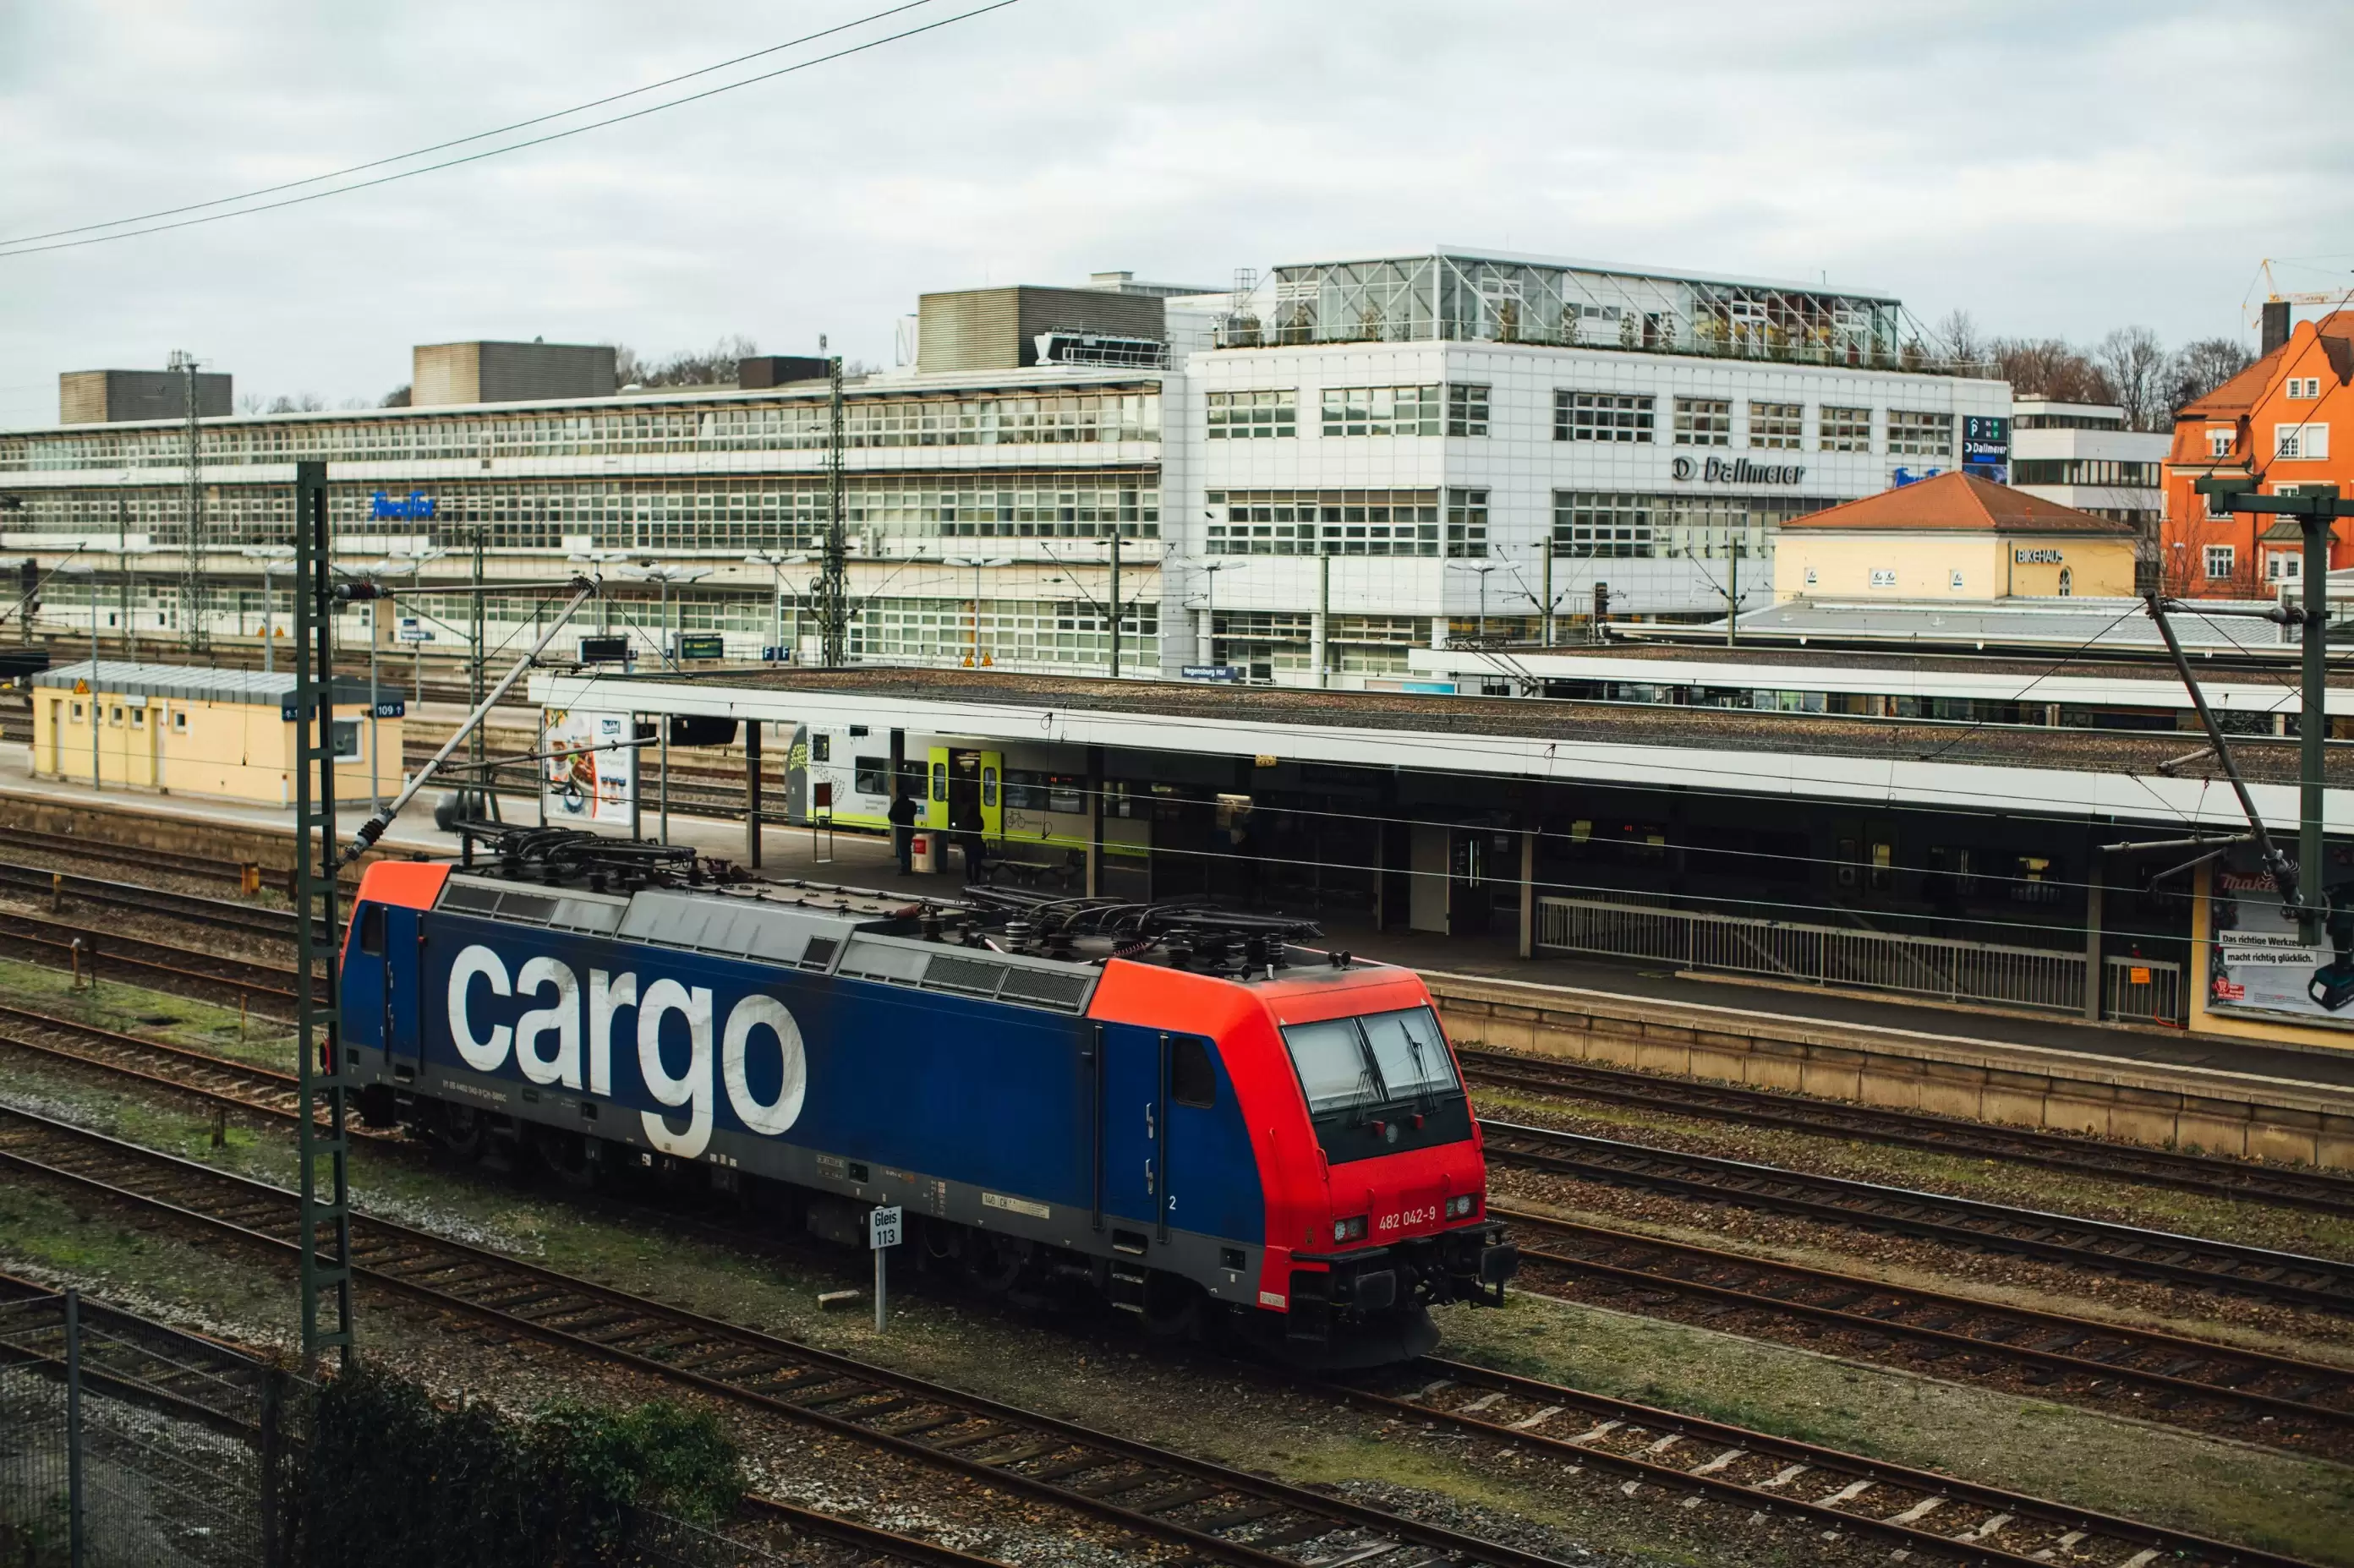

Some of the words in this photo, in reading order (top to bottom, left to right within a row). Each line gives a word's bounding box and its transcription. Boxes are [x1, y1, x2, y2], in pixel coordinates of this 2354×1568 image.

[1973, 442, 2007, 455] Dallmeier
[1705, 456, 1806, 485] Dallmeier
[2016, 549, 2064, 564] BIKEHAUS
[764, 648, 771, 658] F
[782, 647, 789, 658] F
[378, 705, 393, 716] 109
[2222, 934, 2237, 943] Das
[2238, 935, 2267, 946] richtige
[2227, 953, 2251, 962] macht
[2253, 953, 2276, 964] richtig
[2278, 953, 2313, 964] glücklich.
[448, 944, 807, 1159] cargo
[984, 1194, 995, 1205] 140
[1169, 1195, 1176, 1210] 2
[875, 1210, 897, 1227] Gleis
[1378, 1213, 1399, 1231] 482
[1403, 1205, 1436, 1226] 042-9
[877, 1229, 895, 1245] 113
